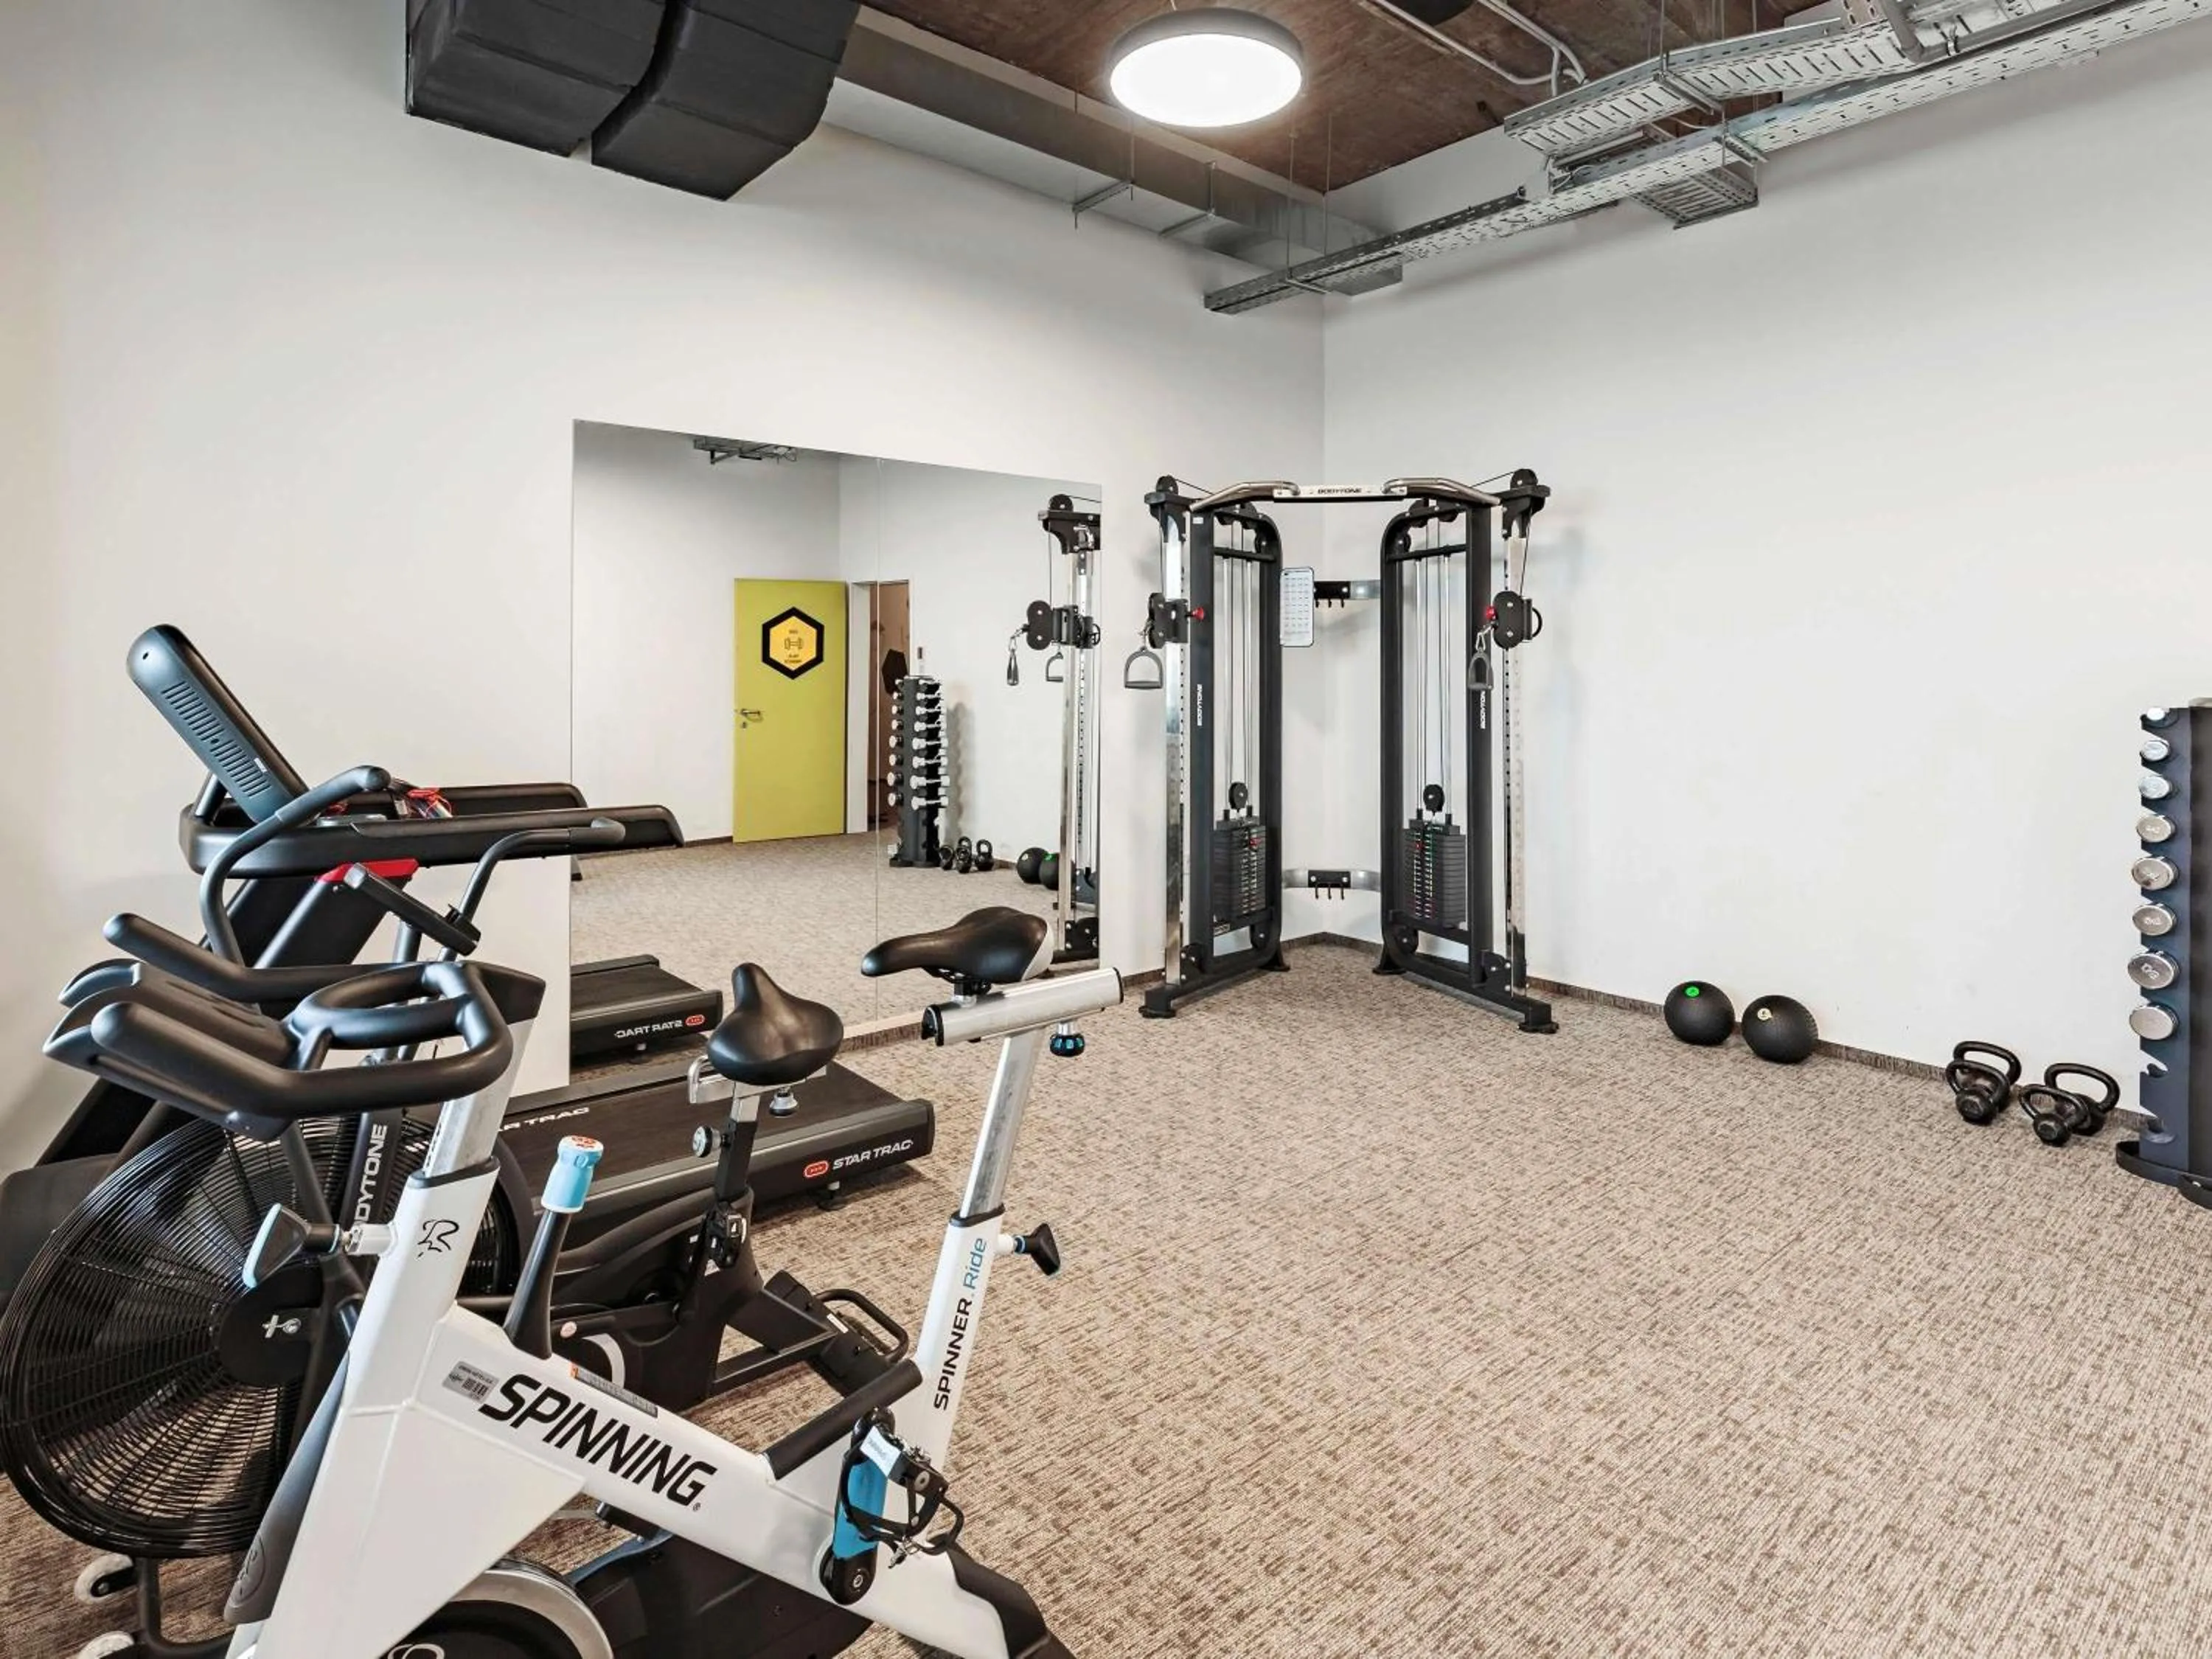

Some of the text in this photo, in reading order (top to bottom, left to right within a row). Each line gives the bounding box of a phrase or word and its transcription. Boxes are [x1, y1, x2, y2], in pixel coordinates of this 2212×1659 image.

[355, 1124, 388, 1222] DYTONE
[832, 1151, 872, 1170] STAR
[873, 1139, 914, 1158] TRAC
[933, 1238, 987, 1411] SPINNER Ride
[478, 1374, 718, 1506] SPINNING
